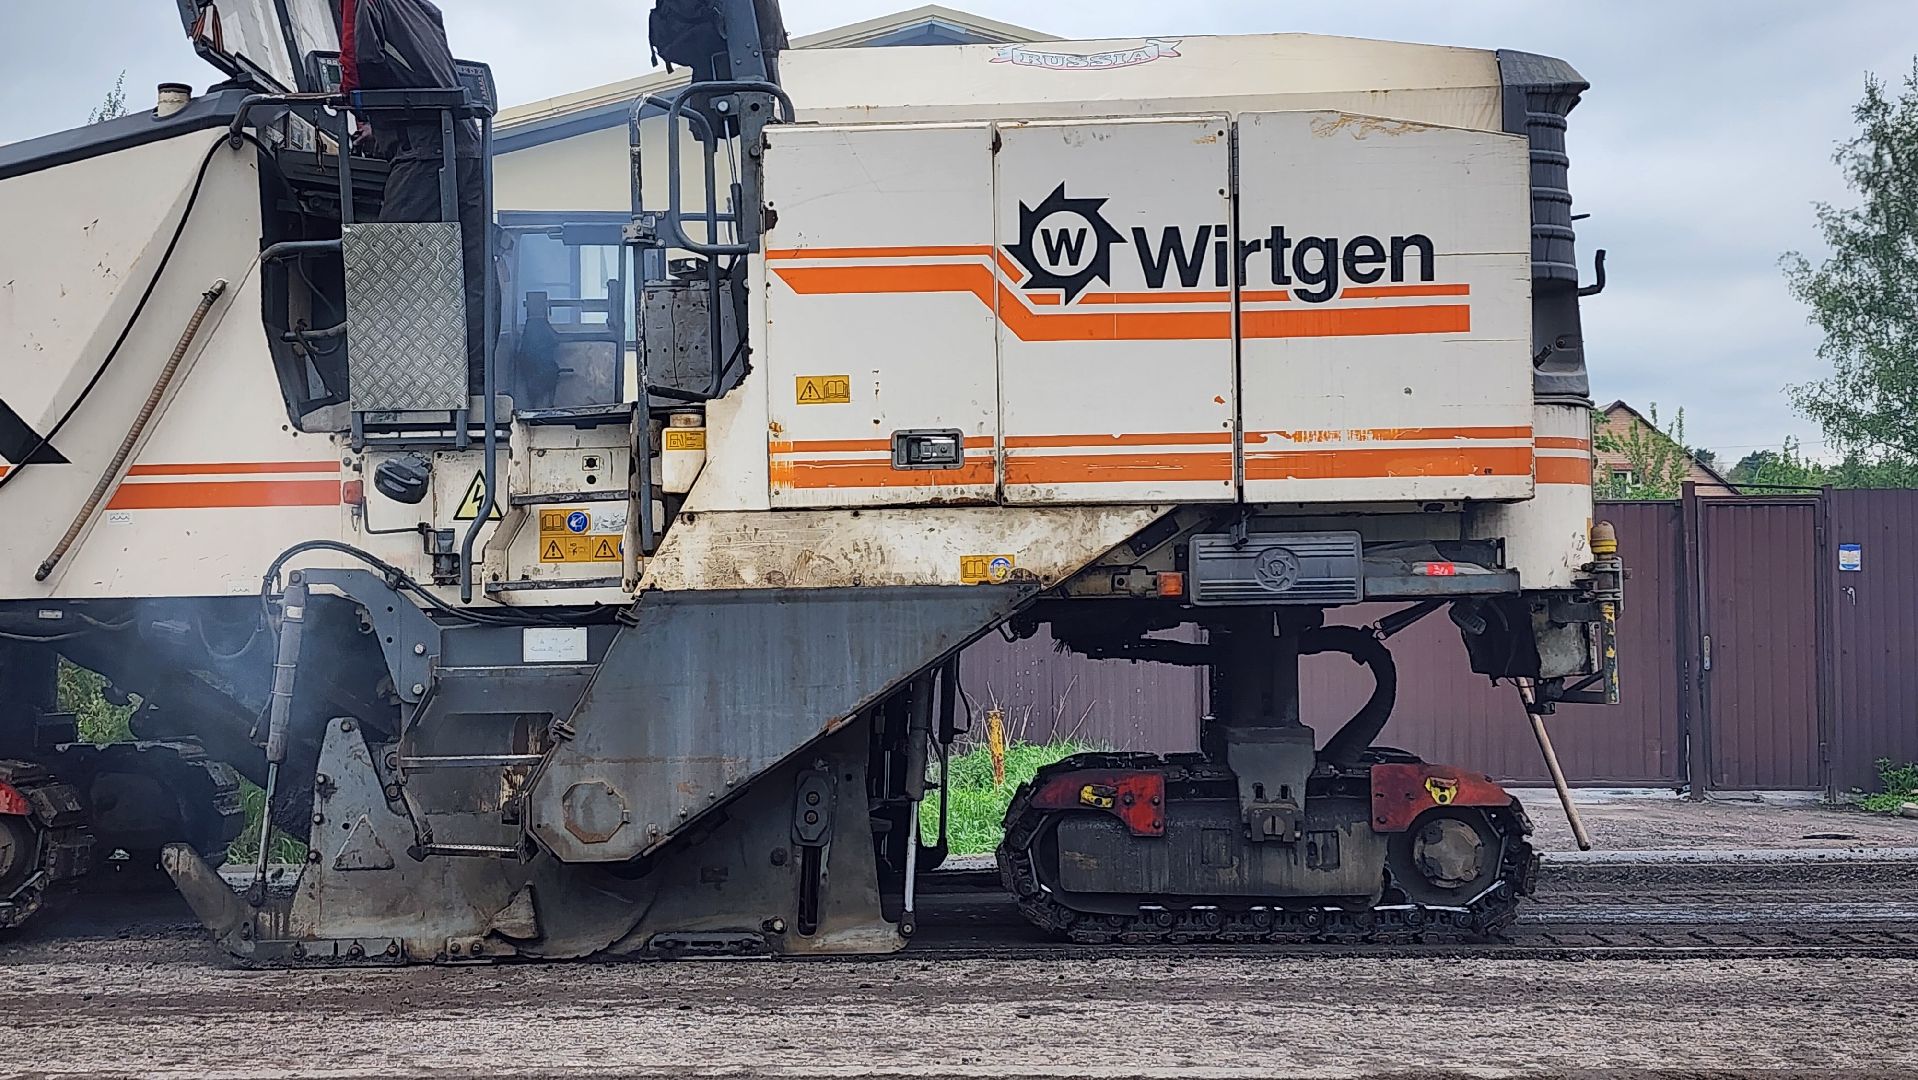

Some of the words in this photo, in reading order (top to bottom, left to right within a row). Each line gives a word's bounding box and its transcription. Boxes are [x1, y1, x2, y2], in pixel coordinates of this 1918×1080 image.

[1020, 49, 1151, 68] RUSSIA
[1040, 228, 1088, 266] W
[1131, 224, 1435, 303] Wirtgen
